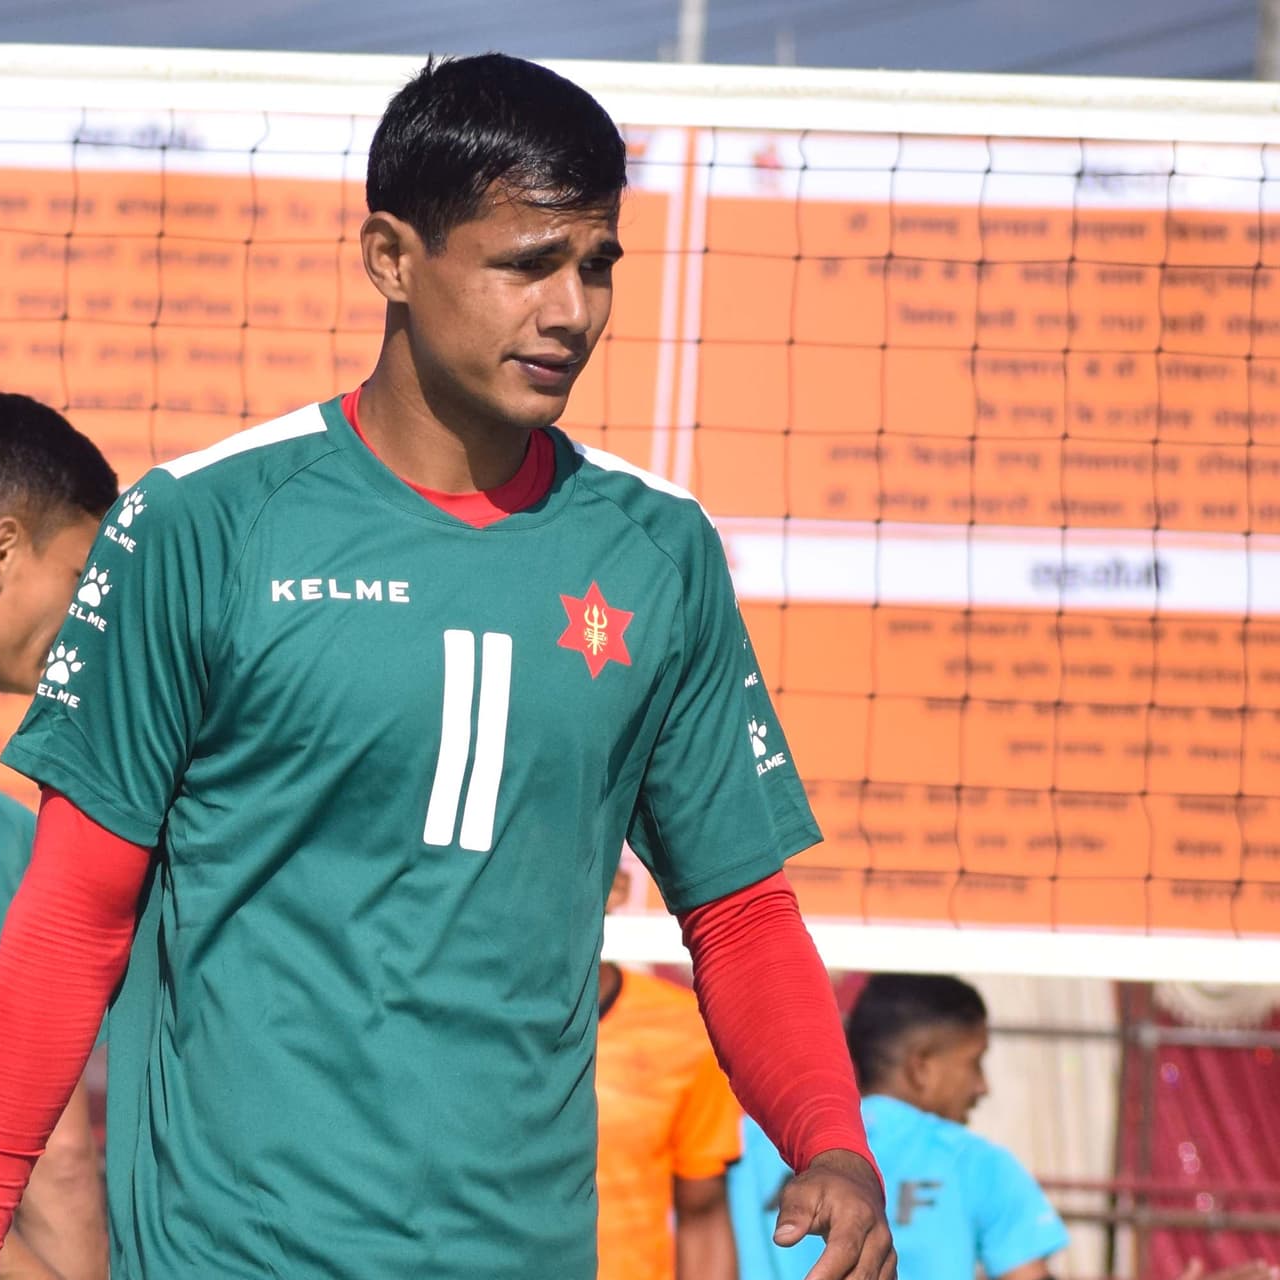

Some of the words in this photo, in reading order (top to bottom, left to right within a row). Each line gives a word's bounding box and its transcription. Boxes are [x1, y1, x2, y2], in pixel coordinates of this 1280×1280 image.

[270, 578, 410, 603] KELME
[68, 603, 107, 632] ELME
[36, 683, 80, 708] ELME
[422, 629, 513, 852] 11
